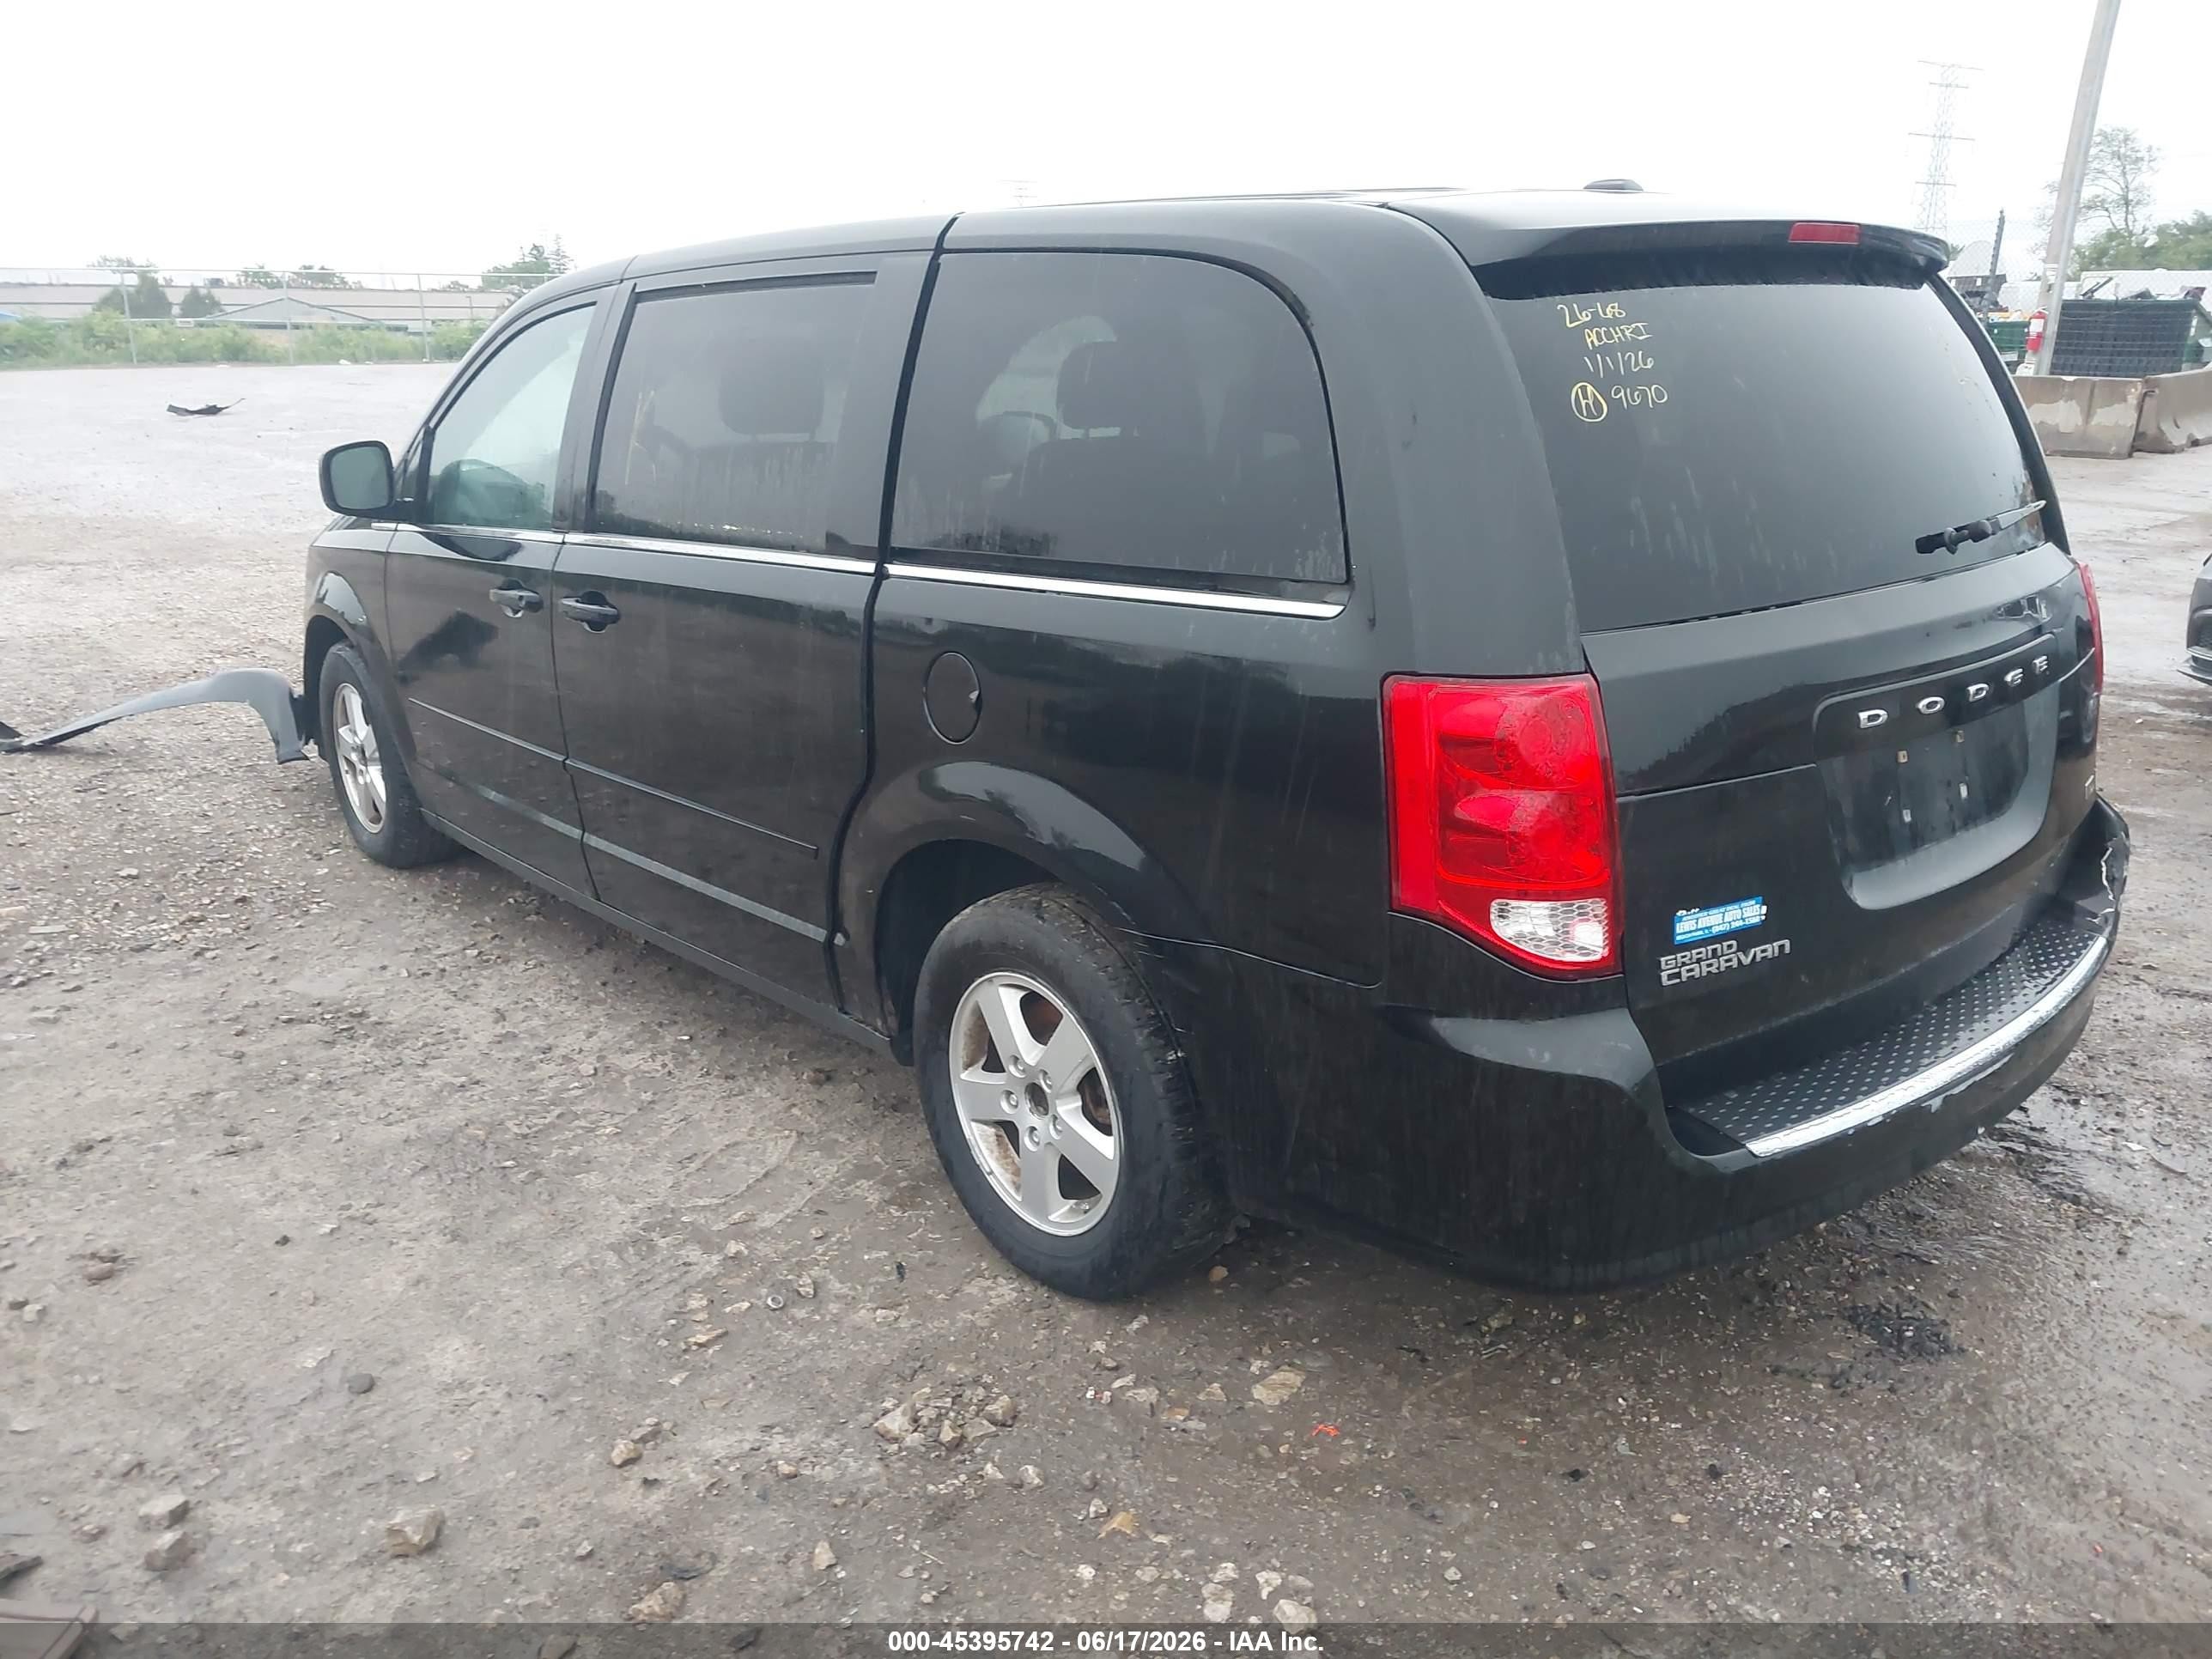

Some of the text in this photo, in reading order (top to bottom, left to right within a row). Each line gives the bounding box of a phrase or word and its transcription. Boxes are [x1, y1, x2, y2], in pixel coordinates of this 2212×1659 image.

[1557, 302, 1626, 328] 26-68
[1583, 350, 1655, 379] 1/1/26
[1611, 384, 1668, 410] 9670
[1857, 655, 2049, 729] DODGE
[1723, 908, 1742, 923] AUTO
[1742, 904, 1761, 919] SALES
[1660, 940, 1738, 970] GRAND
[1660, 939, 1791, 987] CARAVAN
